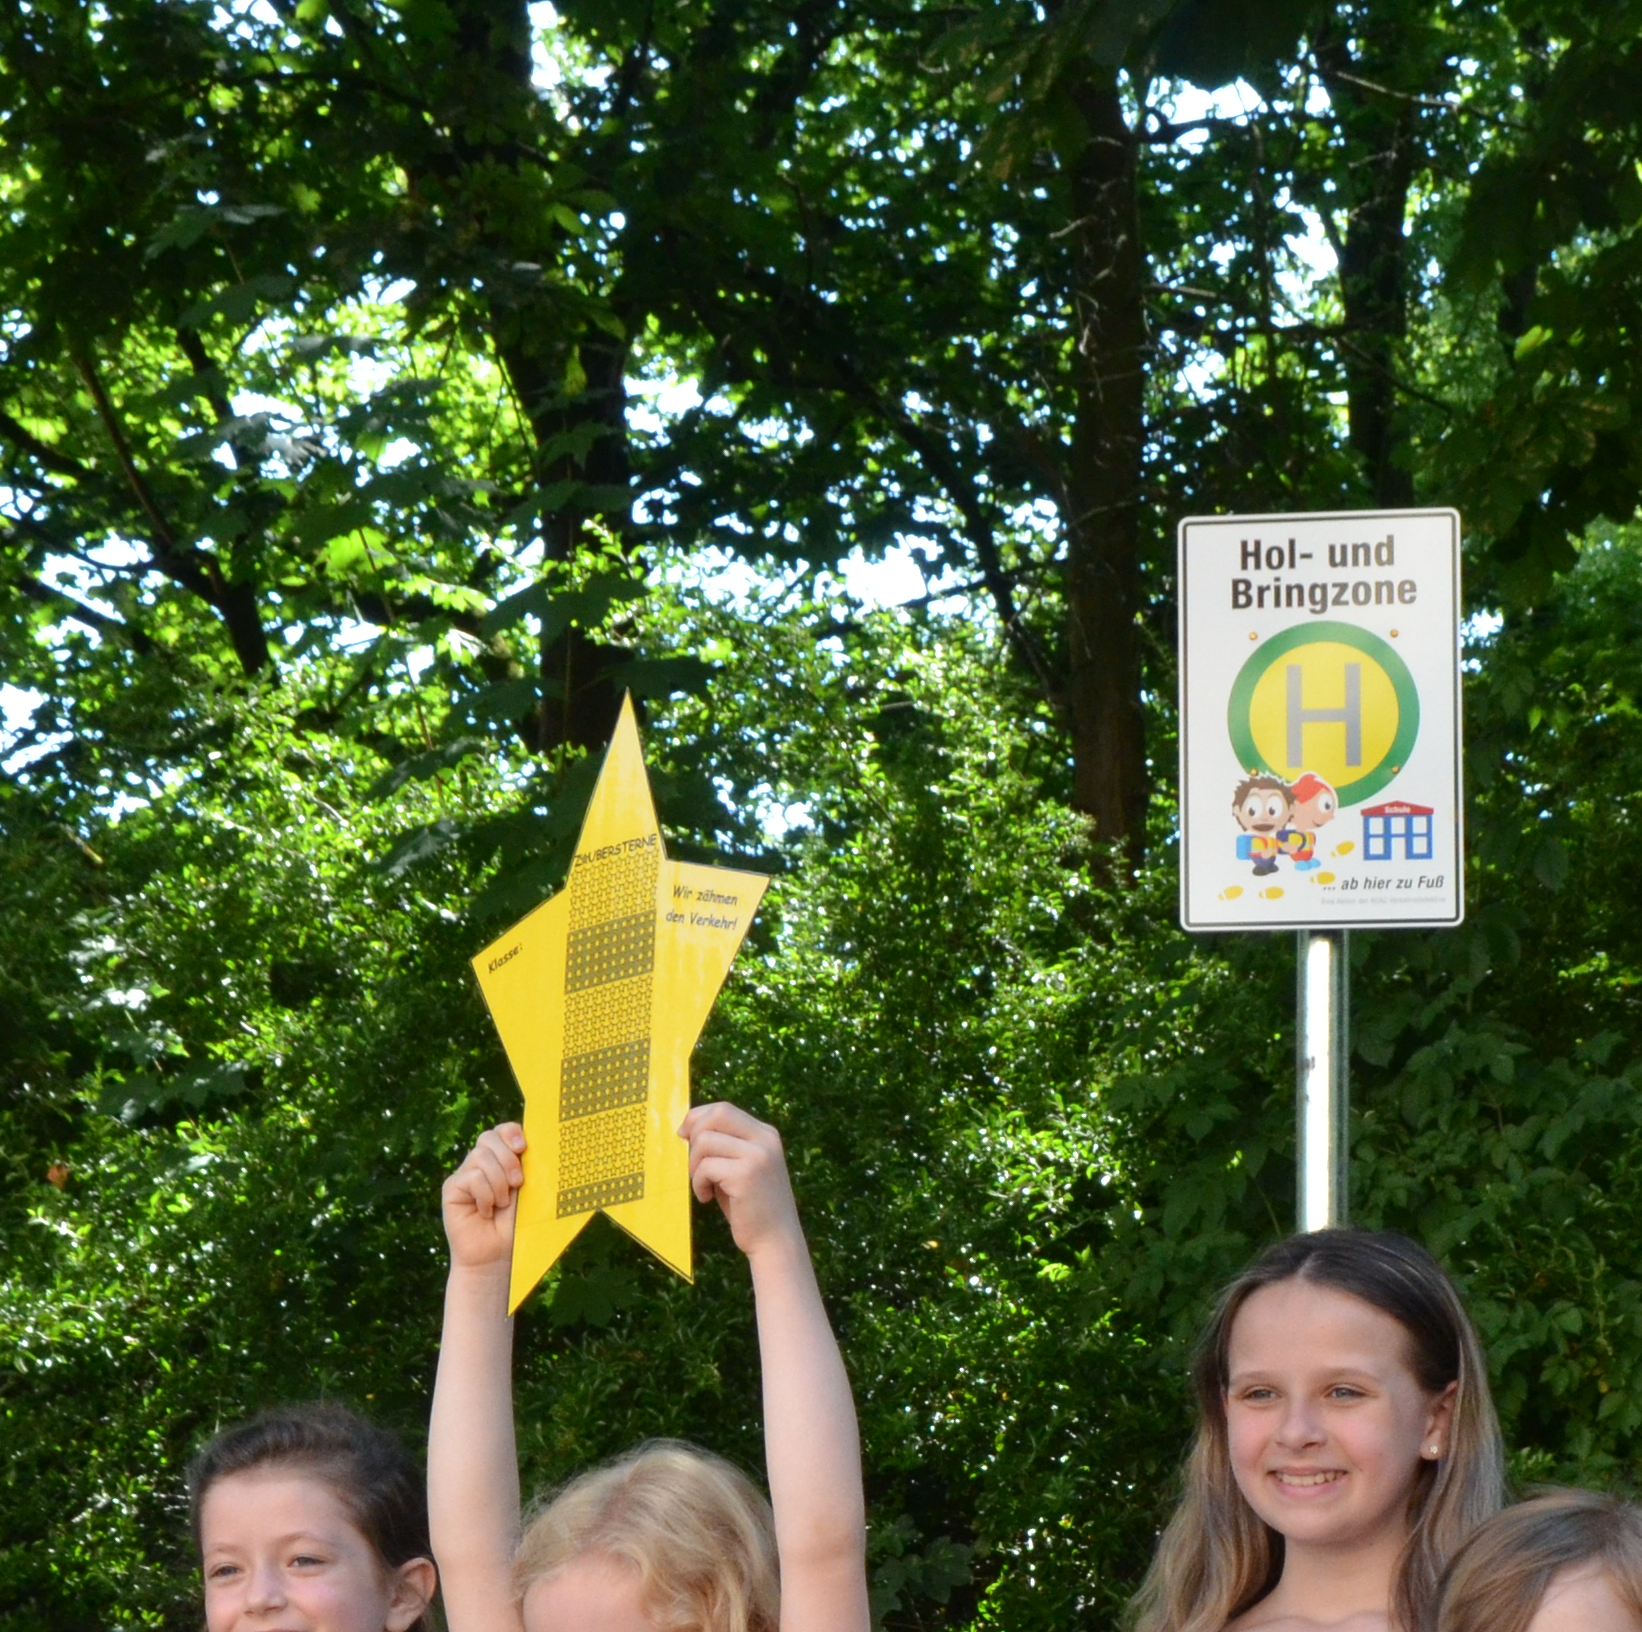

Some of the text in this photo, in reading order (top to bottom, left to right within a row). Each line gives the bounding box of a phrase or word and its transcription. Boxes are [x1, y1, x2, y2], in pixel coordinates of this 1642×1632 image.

[1240, 534, 1395, 571] Hol- und
[1231, 576, 1418, 615] Bringzone
[1286, 663, 1361, 769] H
[574, 833, 657, 867] ZUBERSTERNE
[672, 884, 738, 906] Wir zähmen
[1341, 876, 1359, 890] ab
[1363, 875, 1392, 890] hier
[1395, 877, 1413, 889] zu
[1417, 874, 1445, 889] Fuß
[666, 908, 738, 931] den Verkehr!
[488, 942, 523, 974] Klasse:
